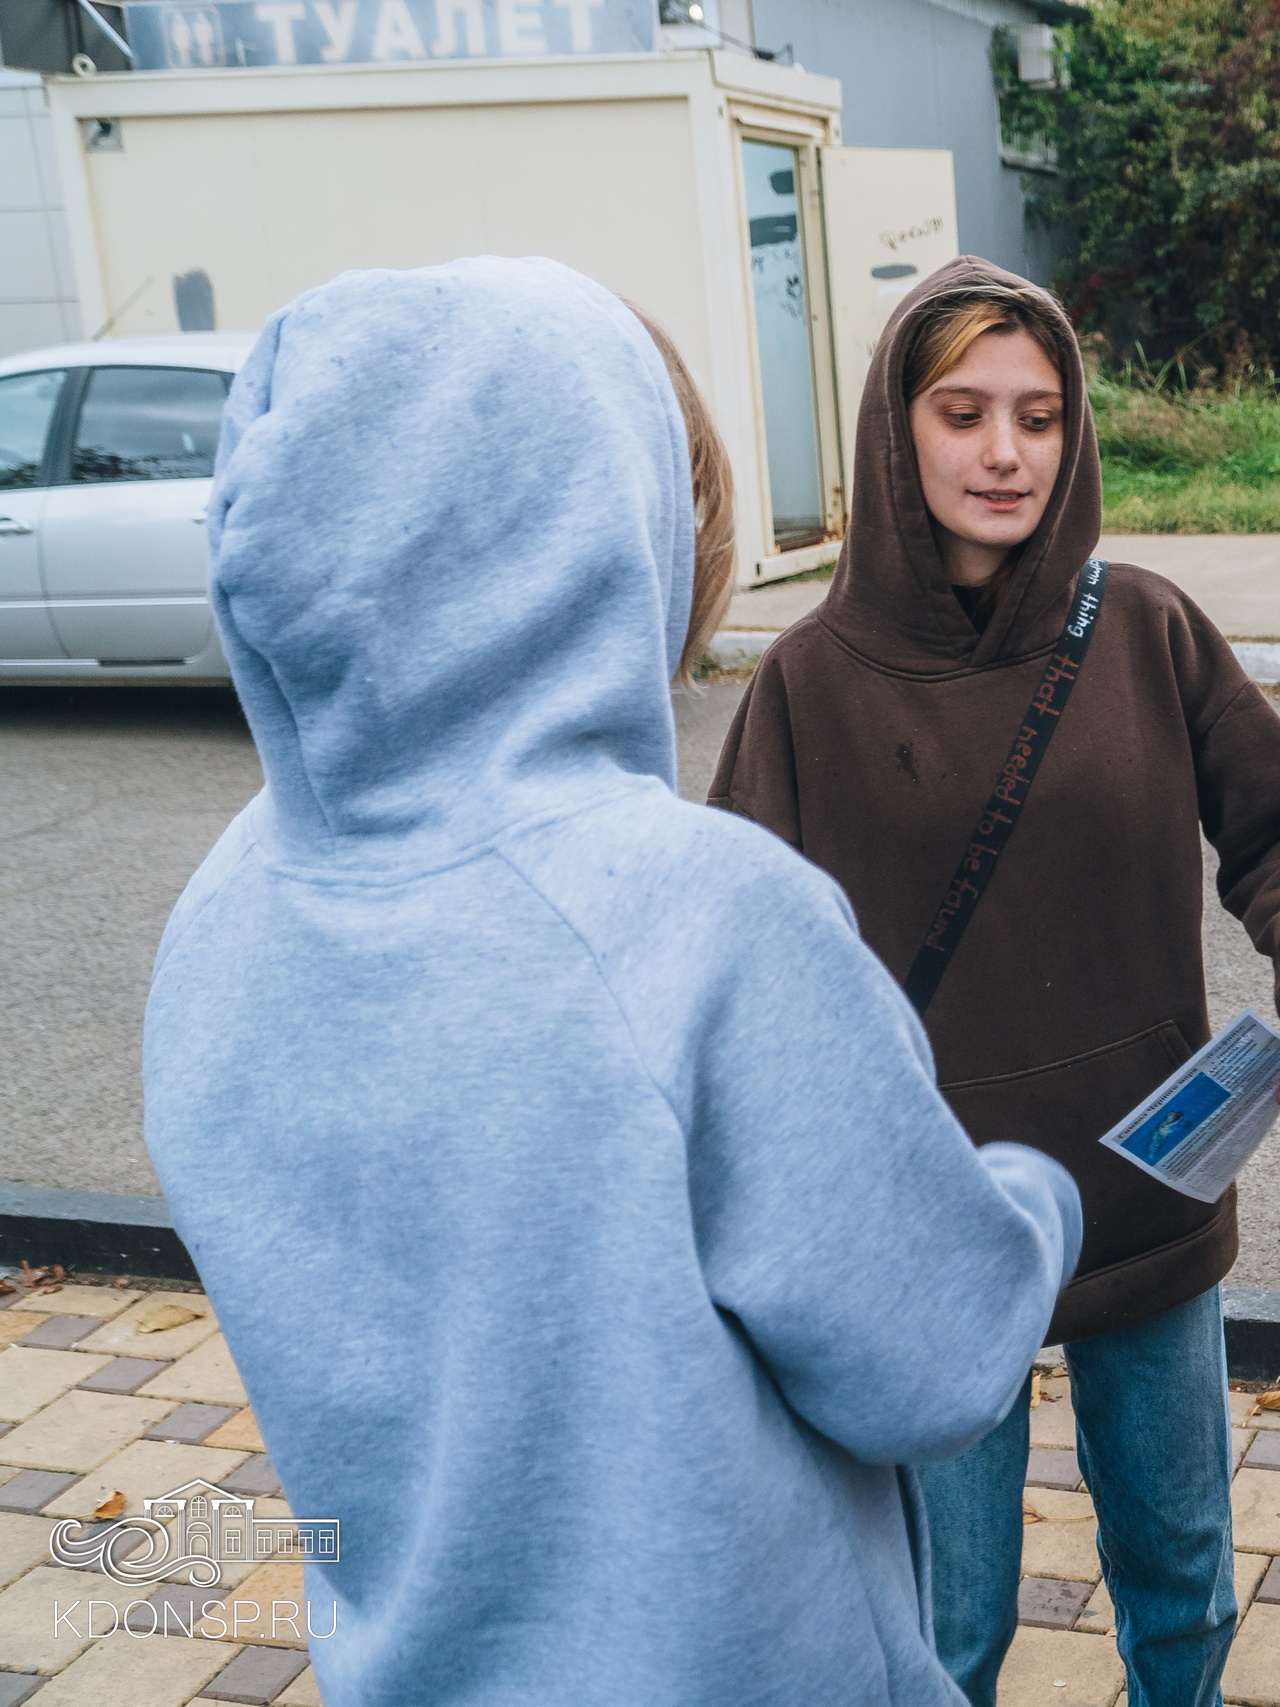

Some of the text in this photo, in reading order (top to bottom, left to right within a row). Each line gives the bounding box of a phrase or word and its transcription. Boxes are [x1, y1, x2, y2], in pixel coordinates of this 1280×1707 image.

[256, 0, 606, 65] ТУАЛЕТ
[1067, 593, 1099, 638] thing
[1048, 654, 1080, 716] that
[996, 725, 1037, 807] needed
[978, 806, 1013, 836] to
[963, 840, 998, 873] be
[925, 877, 979, 952] found
